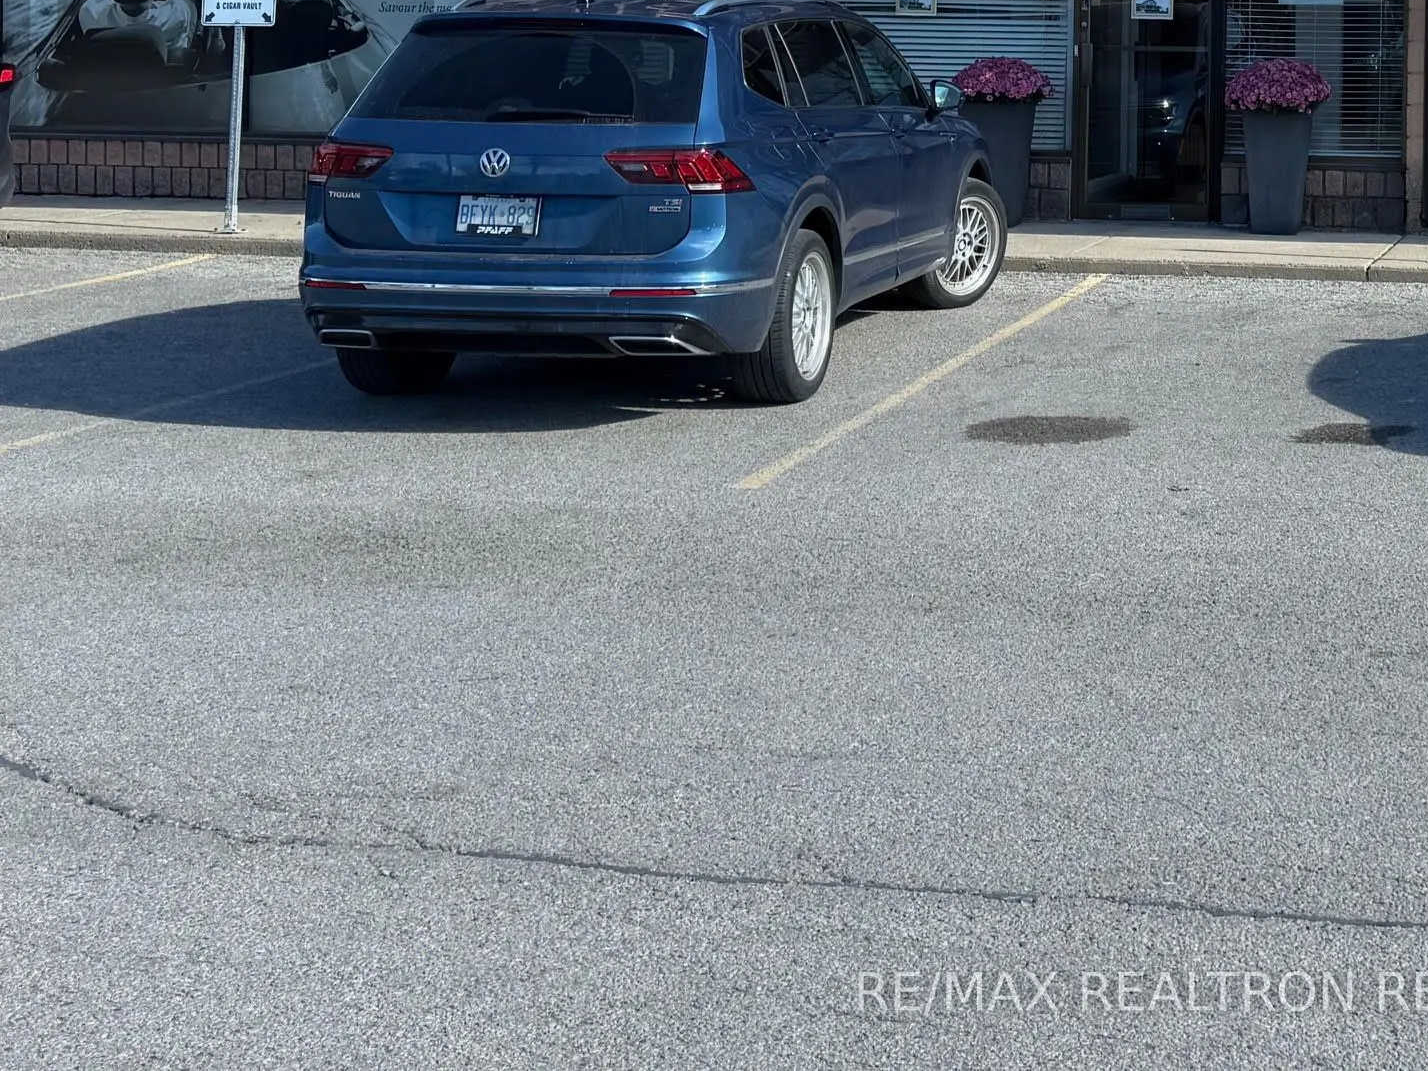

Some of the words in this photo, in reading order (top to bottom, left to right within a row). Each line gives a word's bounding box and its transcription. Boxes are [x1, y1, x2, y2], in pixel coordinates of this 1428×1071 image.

[216, 2, 221, 10] &
[222, 2, 240, 10] CIGAR
[243, 2, 262, 10] VAULT
[378, 1, 417, 13] Savour
[418, 1, 435, 13] the
[328, 190, 361, 199] TIGUAN
[507, 205, 535, 225] 829
[476, 226, 514, 235] PFAFF
